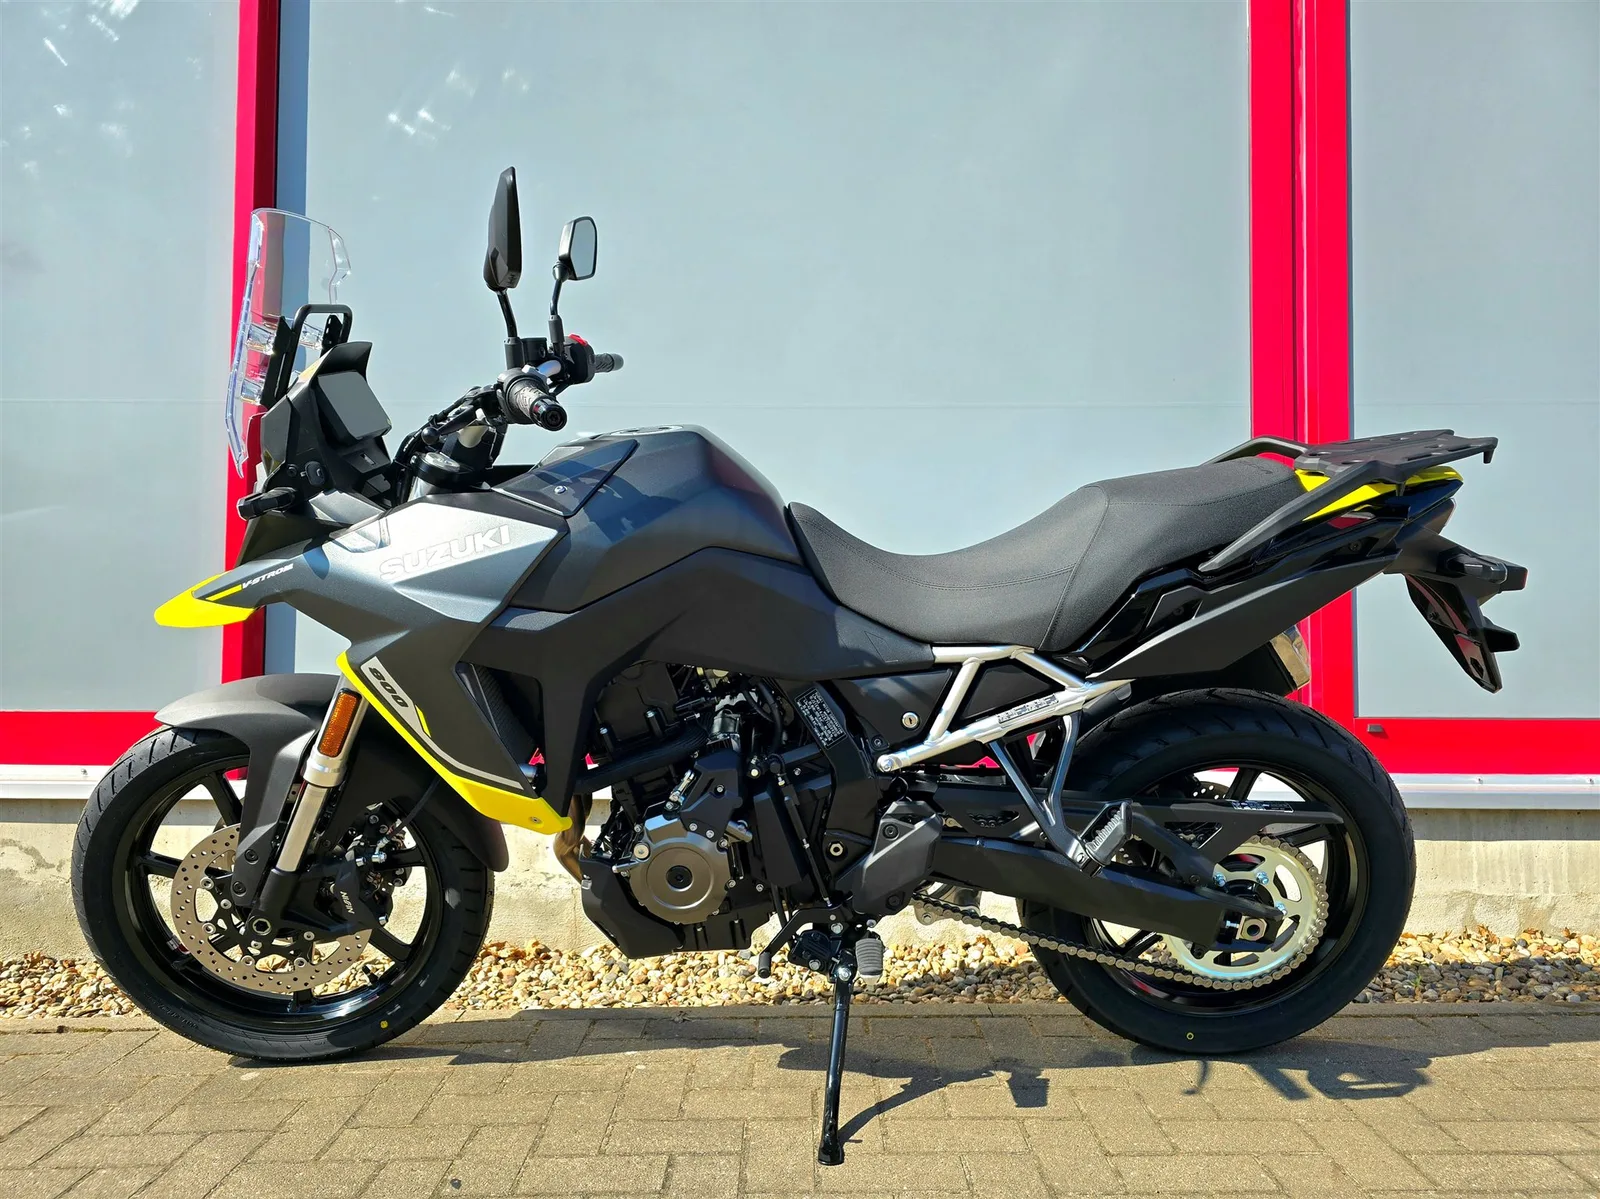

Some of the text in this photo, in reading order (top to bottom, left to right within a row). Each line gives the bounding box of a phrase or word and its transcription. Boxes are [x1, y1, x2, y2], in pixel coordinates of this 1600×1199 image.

[379, 524, 511, 581] SUZUKI
[242, 563, 294, 589] V-STROM
[368, 667, 409, 708] 800
